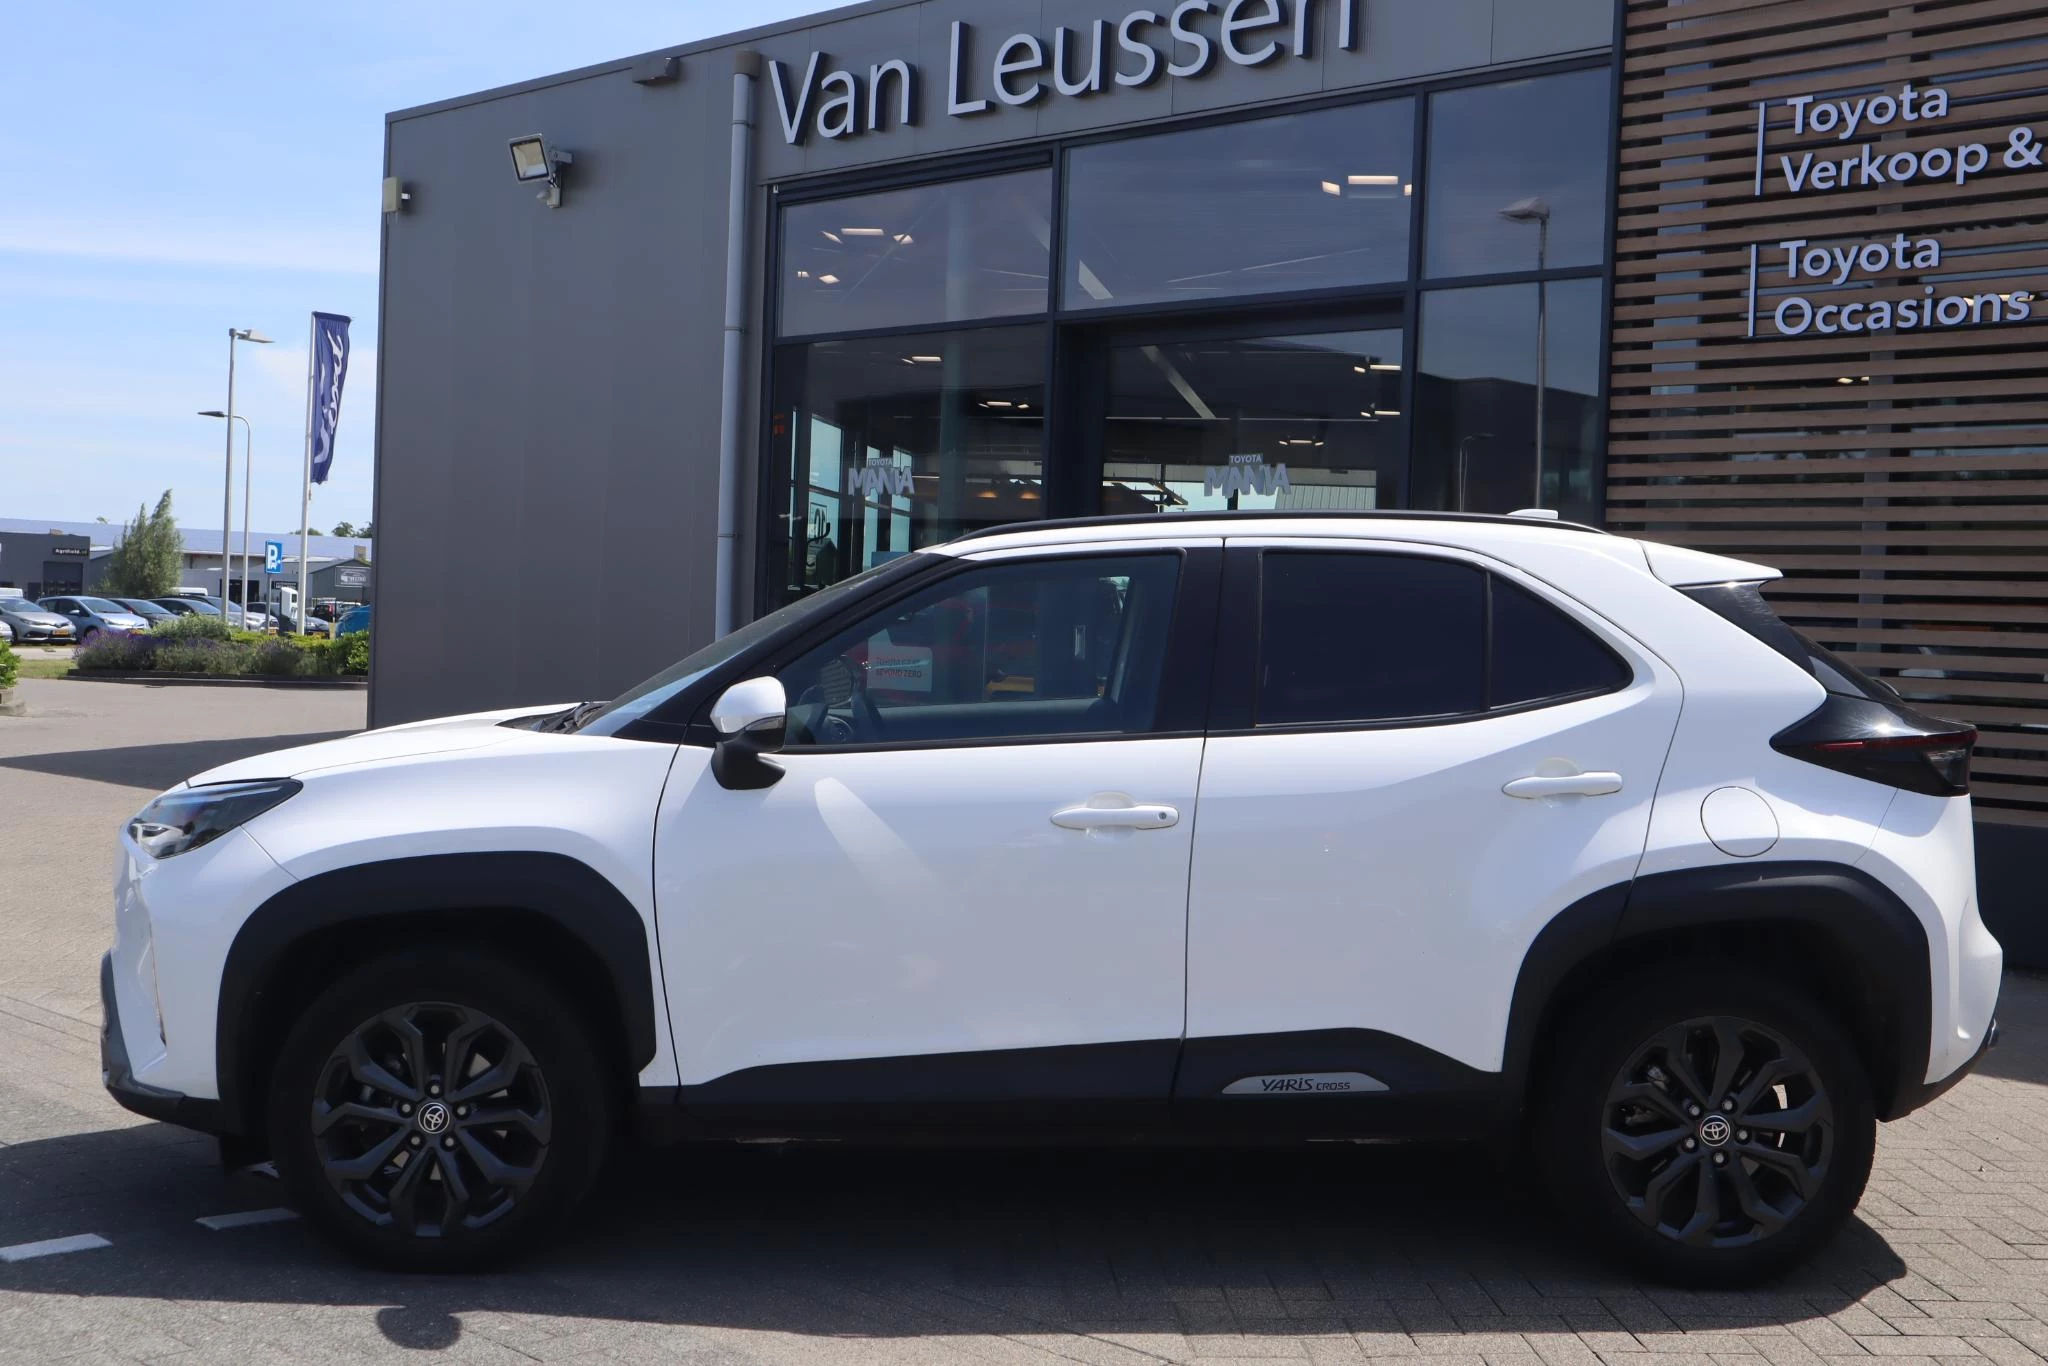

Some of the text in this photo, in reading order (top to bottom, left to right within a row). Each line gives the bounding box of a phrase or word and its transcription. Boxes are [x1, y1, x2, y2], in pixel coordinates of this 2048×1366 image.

[767, 0, 1356, 145] Van Leussen
[1786, 84, 1949, 140] Toyota
[1780, 127, 2043, 193] Verkoop &
[1779, 233, 1941, 286] Toyota
[1774, 286, 2032, 335] Occasions
[1230, 455, 1262, 463] TOYOTA
[267, 544, 279, 569] P
[1317, 1082, 1350, 1091] CROSS
